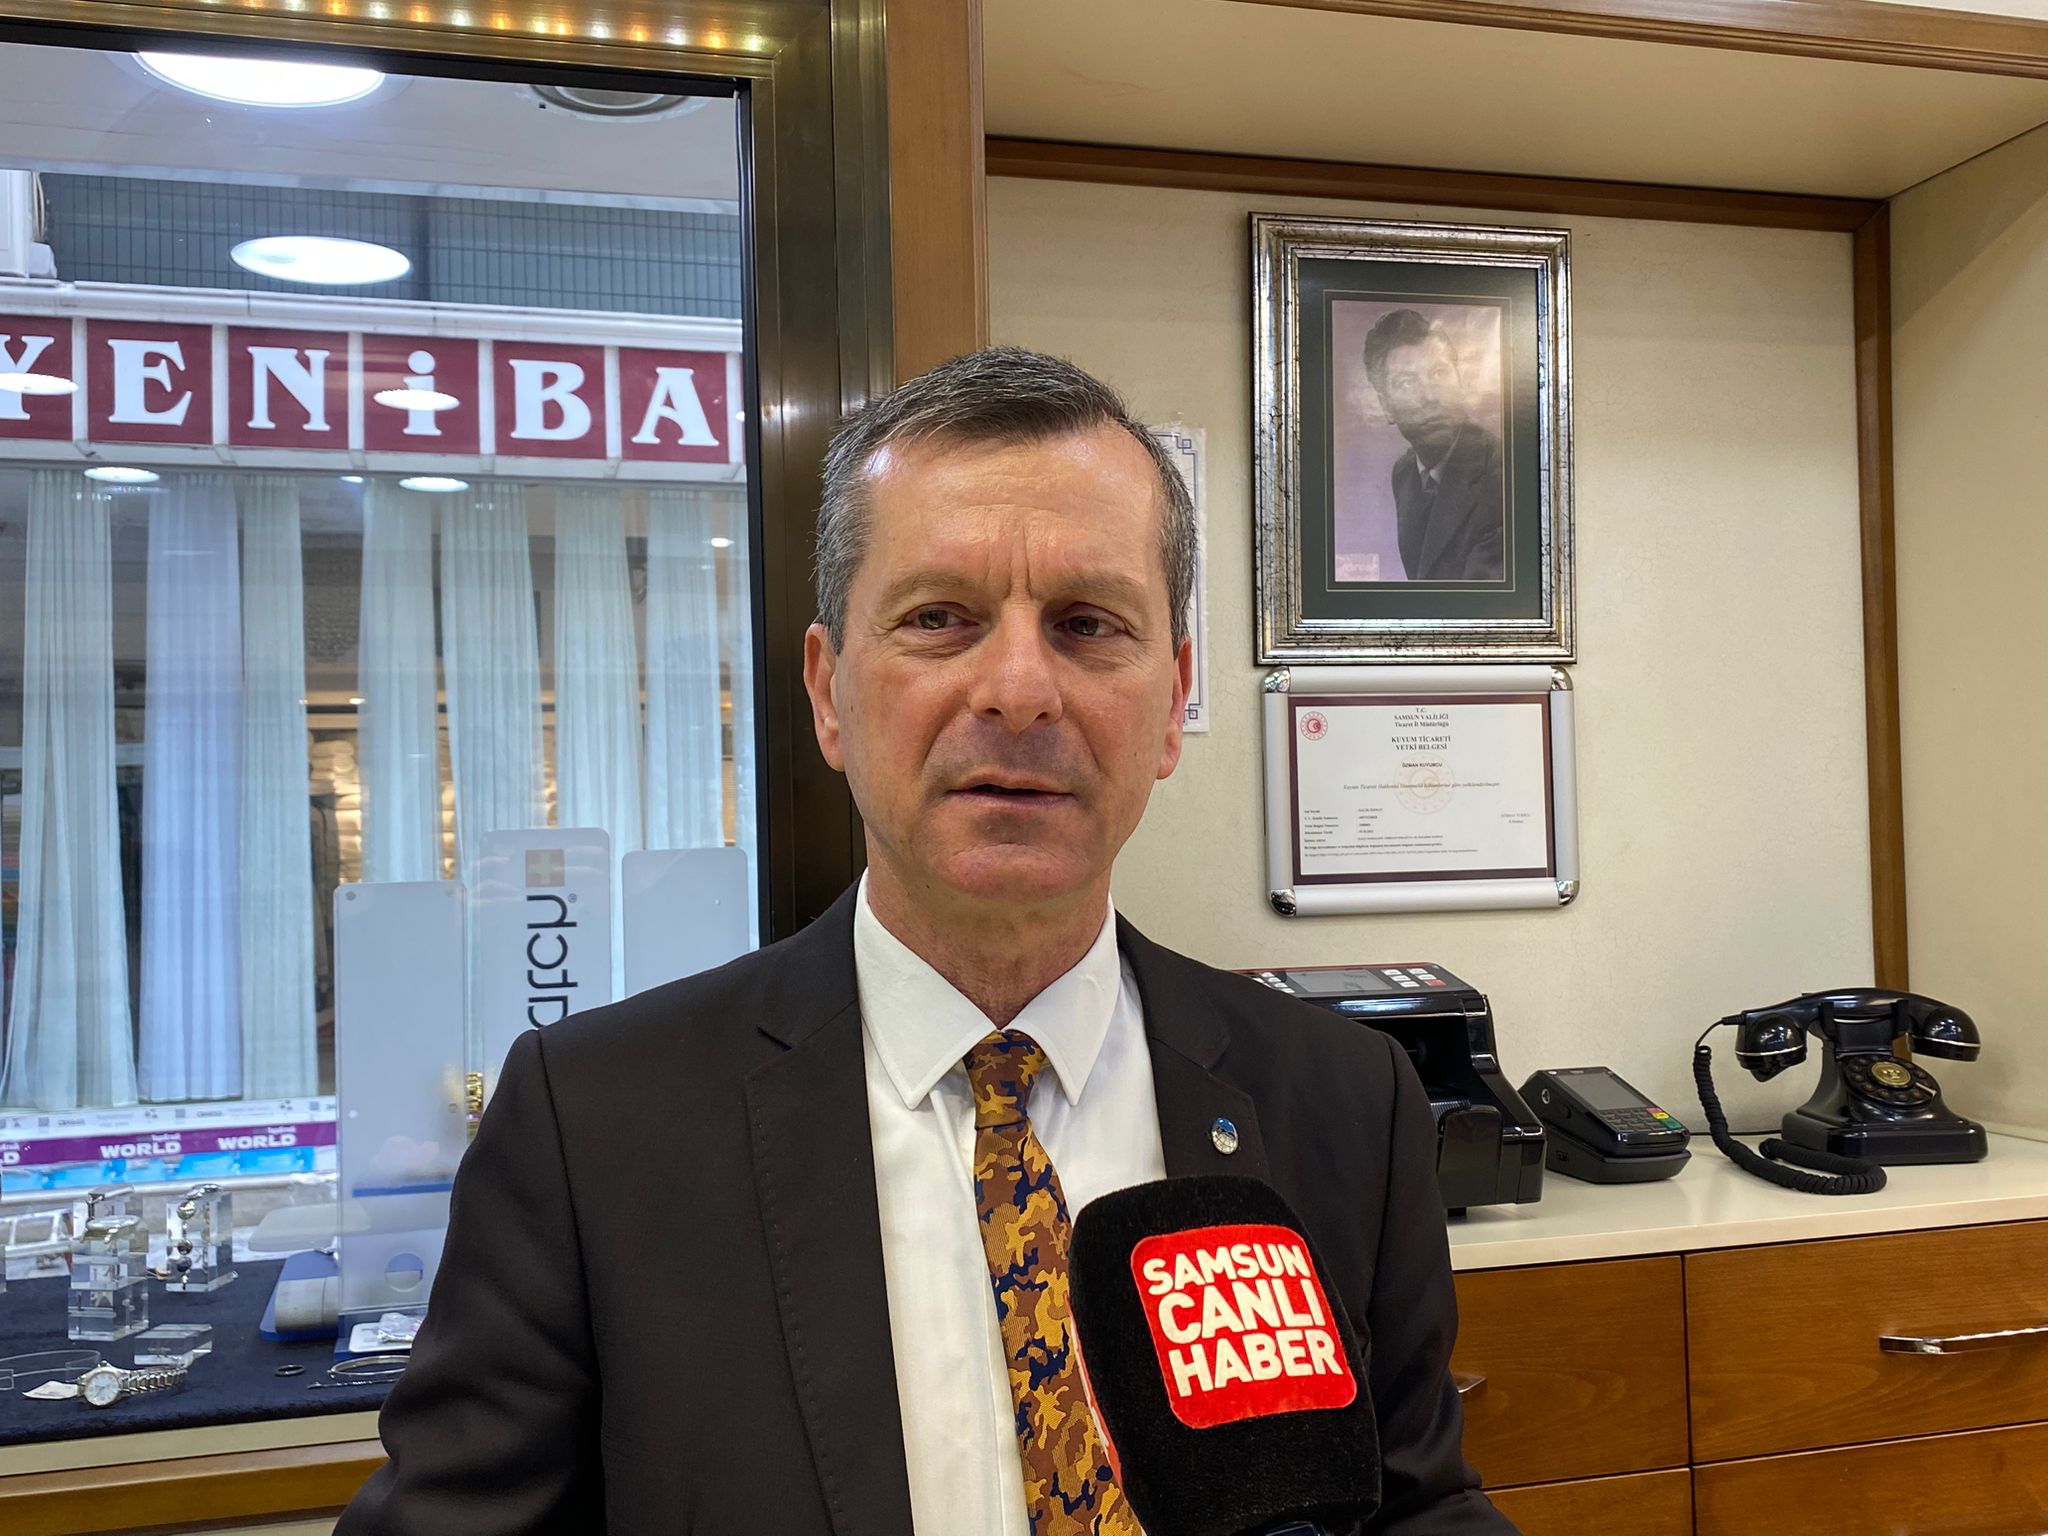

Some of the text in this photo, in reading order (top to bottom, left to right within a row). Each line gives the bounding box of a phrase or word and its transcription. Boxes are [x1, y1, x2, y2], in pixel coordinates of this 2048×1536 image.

[1418, 735, 1451, 743] TİCARETİ
[1418, 742, 1447, 750] BELGESİ
[100, 1139, 181, 1160] WORLD
[217, 1132, 298, 1151] WORLD
[1142, 1243, 1311, 1296] SAMSUN
[1158, 1278, 1326, 1344] CANLI
[1168, 1330, 1344, 1397] HABER
